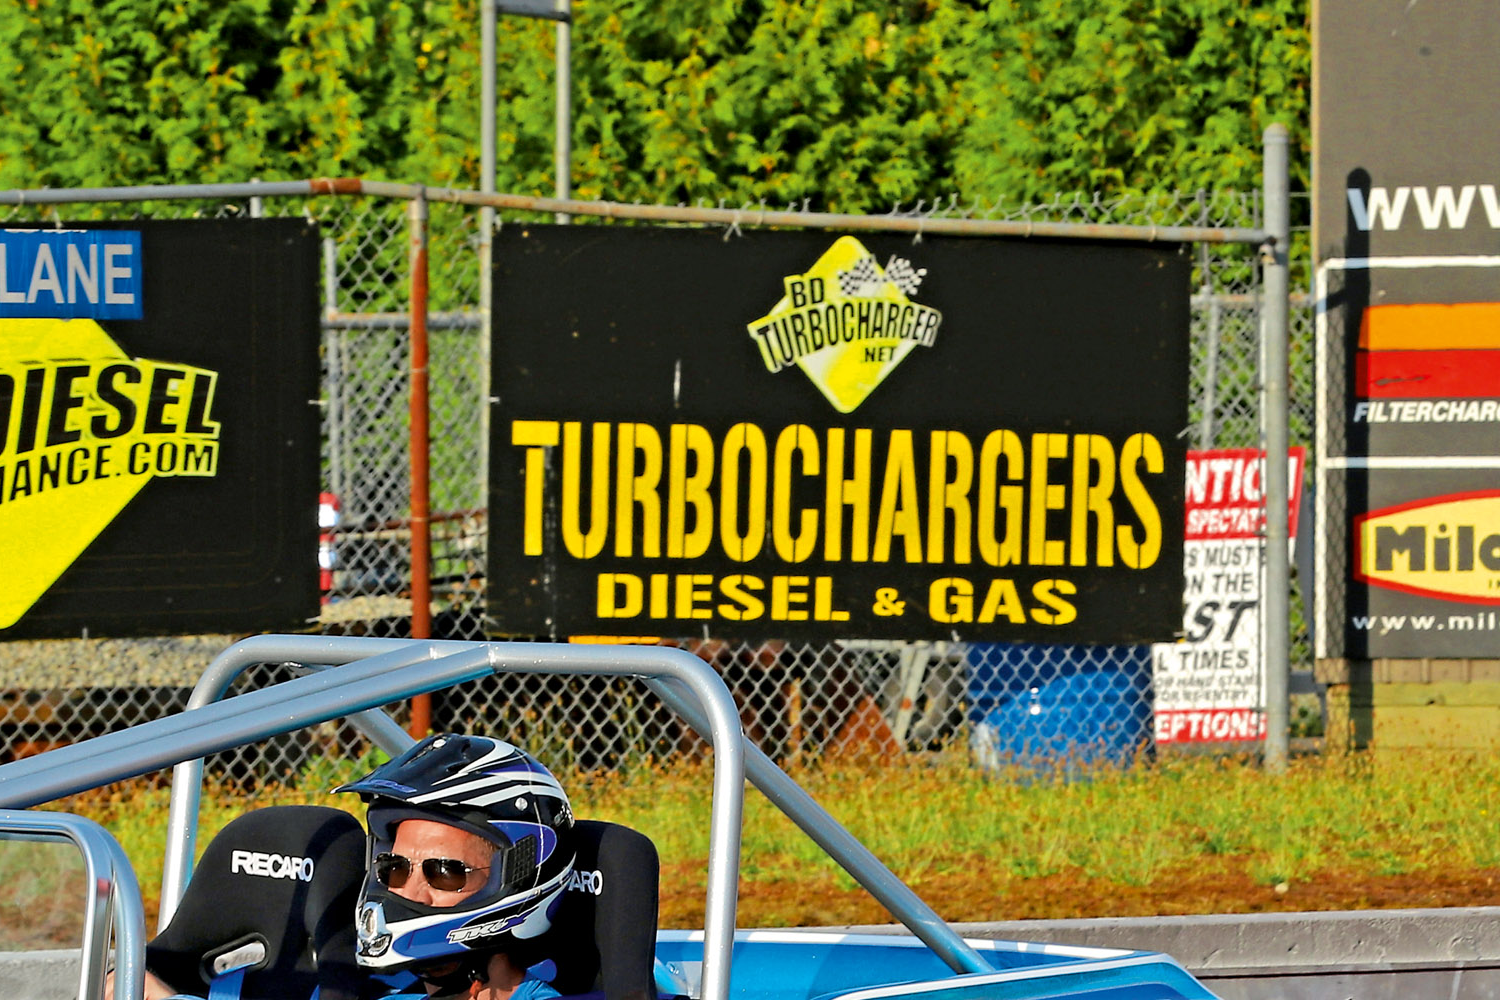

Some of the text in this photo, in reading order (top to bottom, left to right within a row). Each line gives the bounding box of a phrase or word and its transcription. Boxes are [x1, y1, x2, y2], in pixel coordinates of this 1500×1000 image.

[791, 278, 825, 309] BD
[757, 302, 940, 369] TURBOCHARGER
[861, 346, 896, 363] .NET
[512, 421, 1164, 570] TURBOCHARGERS
[1204, 546, 1255, 566] MUST
[1212, 573, 1253, 593] THE
[596, 574, 1078, 625] DIESEL & GAS
[1185, 600, 1259, 643] ST
[1179, 651, 1249, 670] TIMES
[231, 850, 314, 882] RECARO
